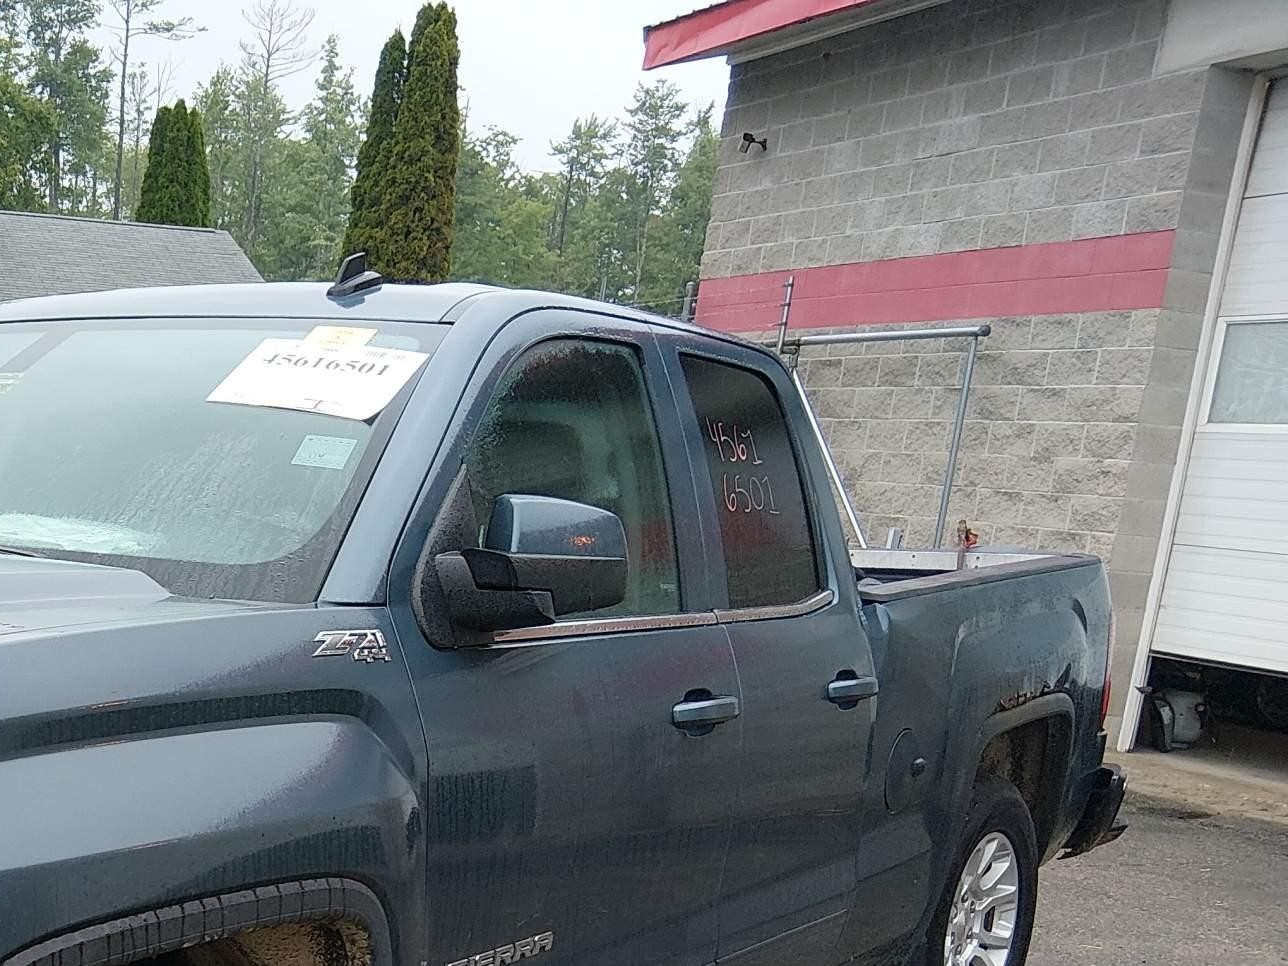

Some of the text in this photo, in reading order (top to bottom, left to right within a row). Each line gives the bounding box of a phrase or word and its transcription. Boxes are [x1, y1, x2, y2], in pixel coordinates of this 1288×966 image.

[263, 352, 391, 375] 45616501
[705, 416, 763, 465] 4561
[723, 472, 781, 515] 6501
[312, 628, 387, 657] Z71
